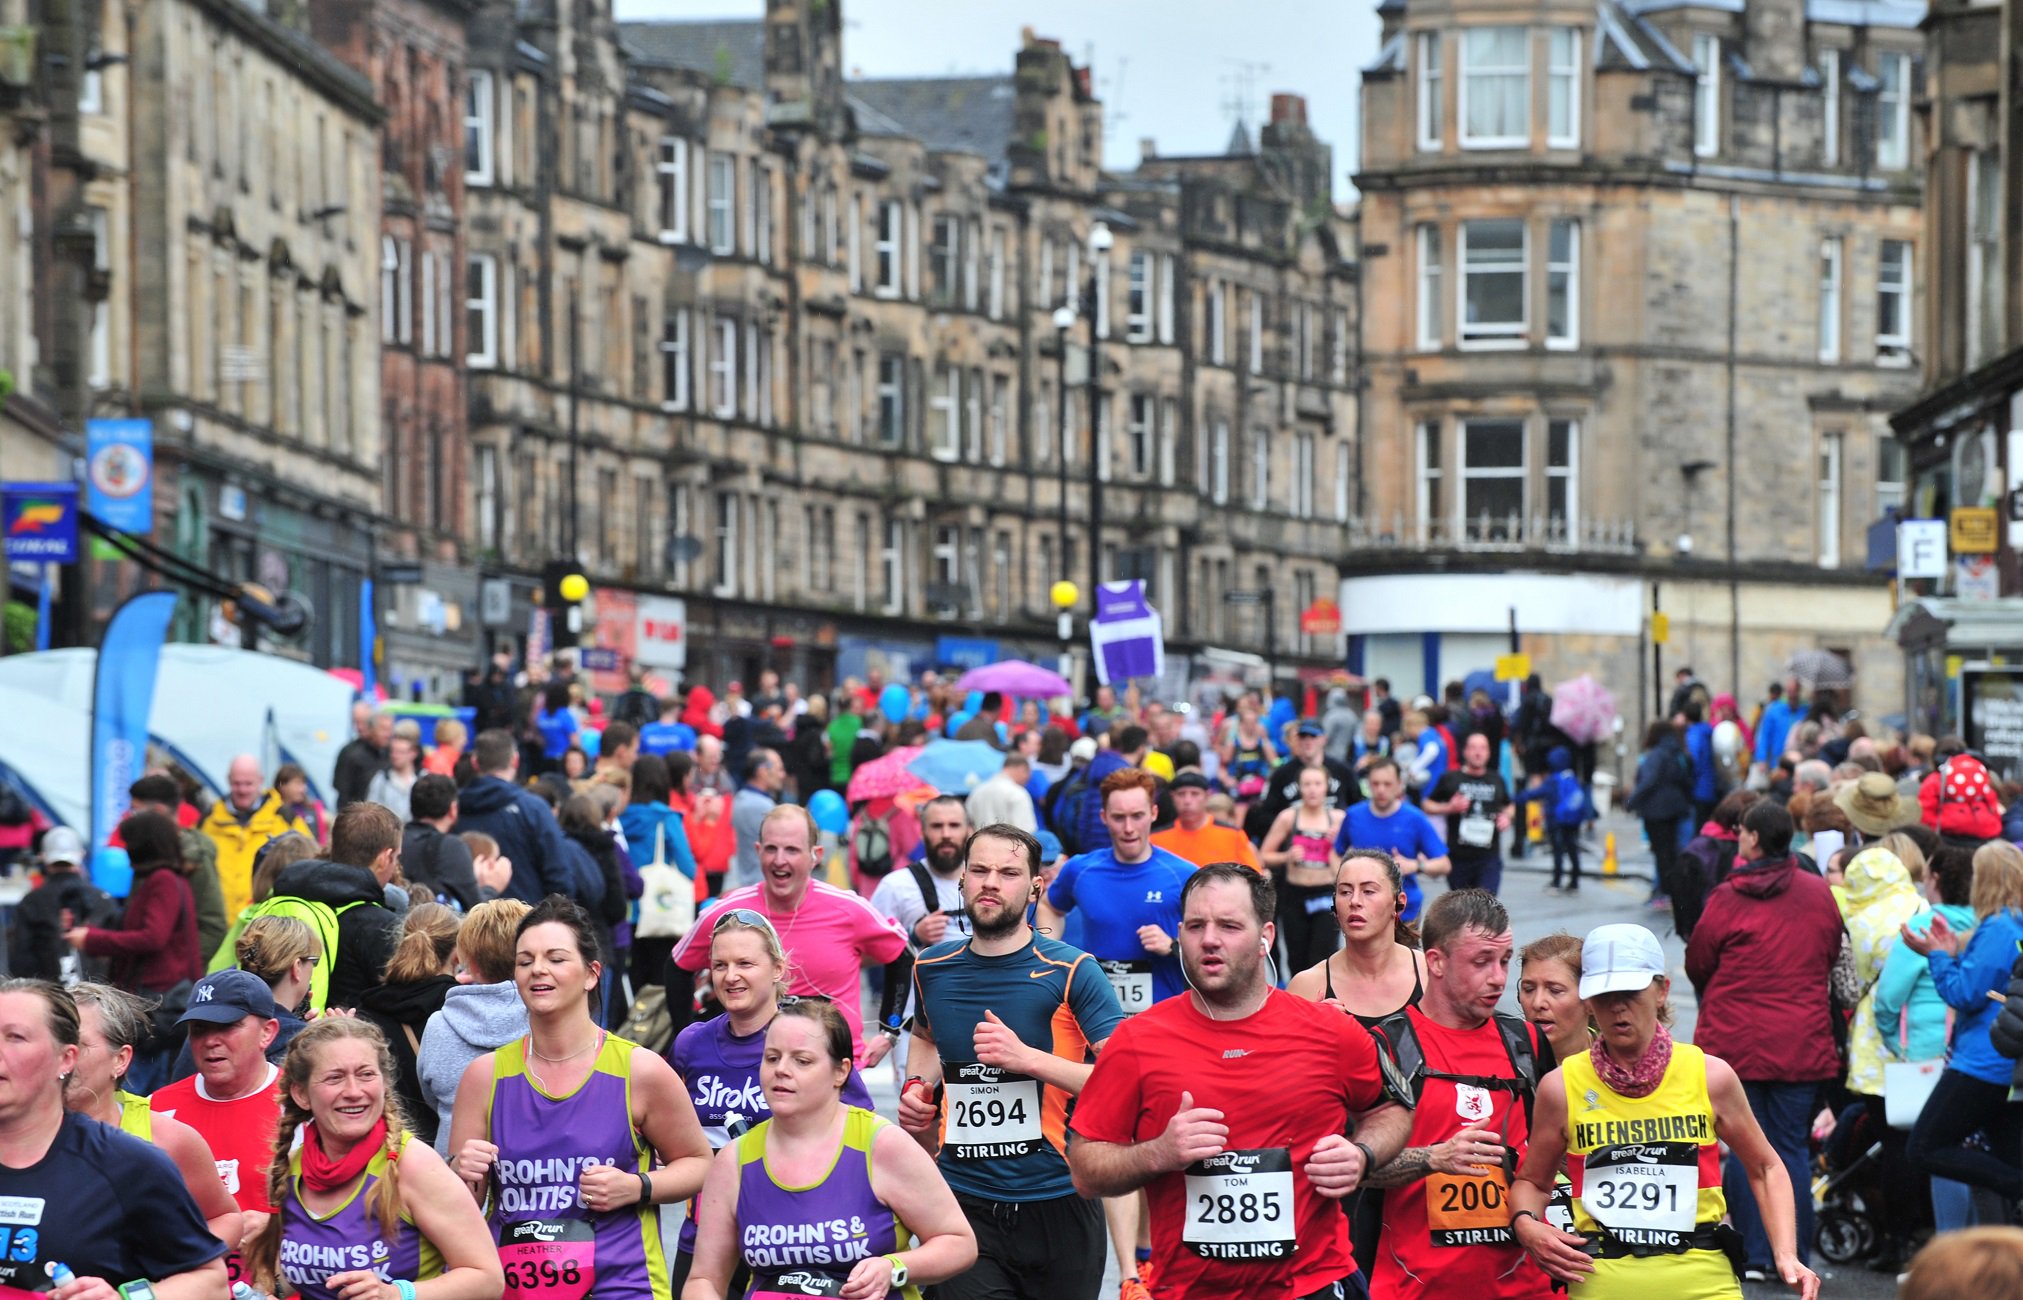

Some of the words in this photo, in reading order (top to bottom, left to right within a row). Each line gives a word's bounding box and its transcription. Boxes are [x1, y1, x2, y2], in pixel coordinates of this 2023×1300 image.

[1111, 984, 1143, 1003] 15
[694, 1075, 771, 1113] Stroke
[970, 1086, 1000, 1095] SIMON
[708, 1113, 753, 1122] assoon
[955, 1098, 1027, 1128] 2694
[1576, 1114, 1708, 1149] HELENSBURGH
[956, 1142, 1029, 1158] STIRLING
[493, 1153, 601, 1185] ROHN'S
[1224, 1177, 1249, 1188] TOM
[1615, 1166, 1666, 1177] ISABELLA
[499, 1184, 577, 1213] OLITIS
[1197, 1191, 1281, 1225] 2885
[1596, 1180, 1677, 1213] 3291
[744, 1218, 850, 1247] CROHN'S
[850, 1215, 866, 1234] &
[1445, 1229, 1512, 1244] STIRLIN
[1607, 1227, 1681, 1247] TIRLING
[280, 1239, 370, 1269] CROHN'S
[371, 1240, 389, 1259] &
[517, 1244, 563, 1255] HEATHER
[744, 1245, 833, 1268] COLITIS
[833, 1238, 873, 1263] UK
[1199, 1241, 1284, 1258] STIRLING
[504, 1259, 581, 1290] 6398
